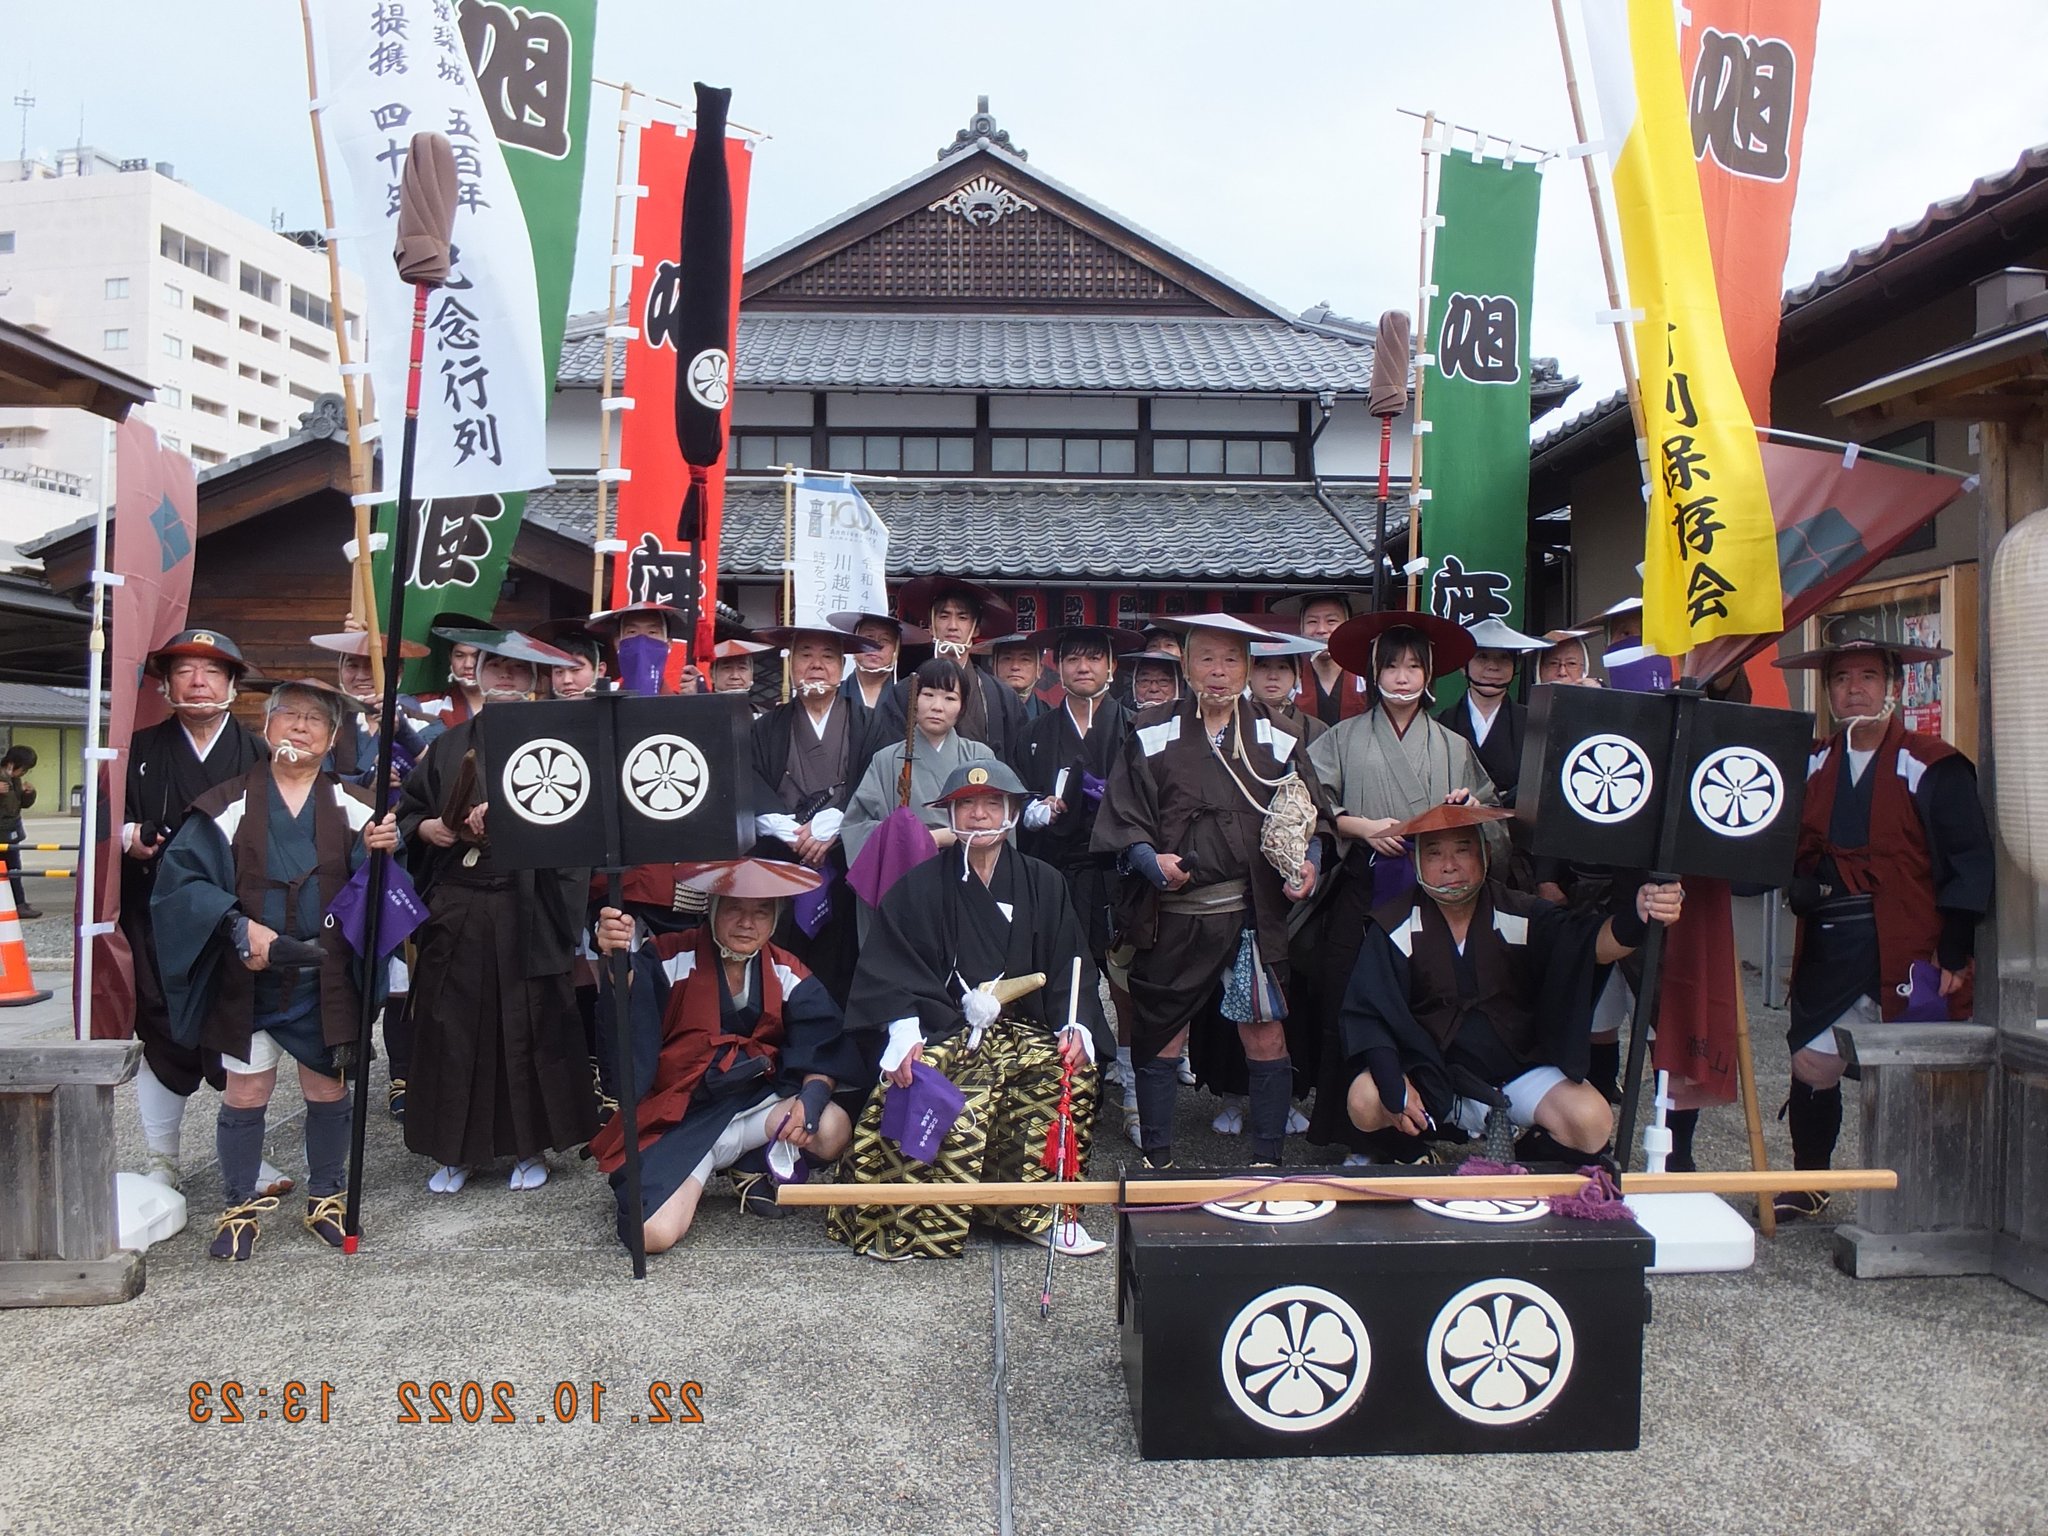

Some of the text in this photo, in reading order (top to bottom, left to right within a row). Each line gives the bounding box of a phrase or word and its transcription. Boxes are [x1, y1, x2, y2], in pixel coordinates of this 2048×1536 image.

[368, 1, 410, 76] 提携
[813, 551, 828, 621] 時をつなぐ
[831, 553, 850, 611] 川越市
